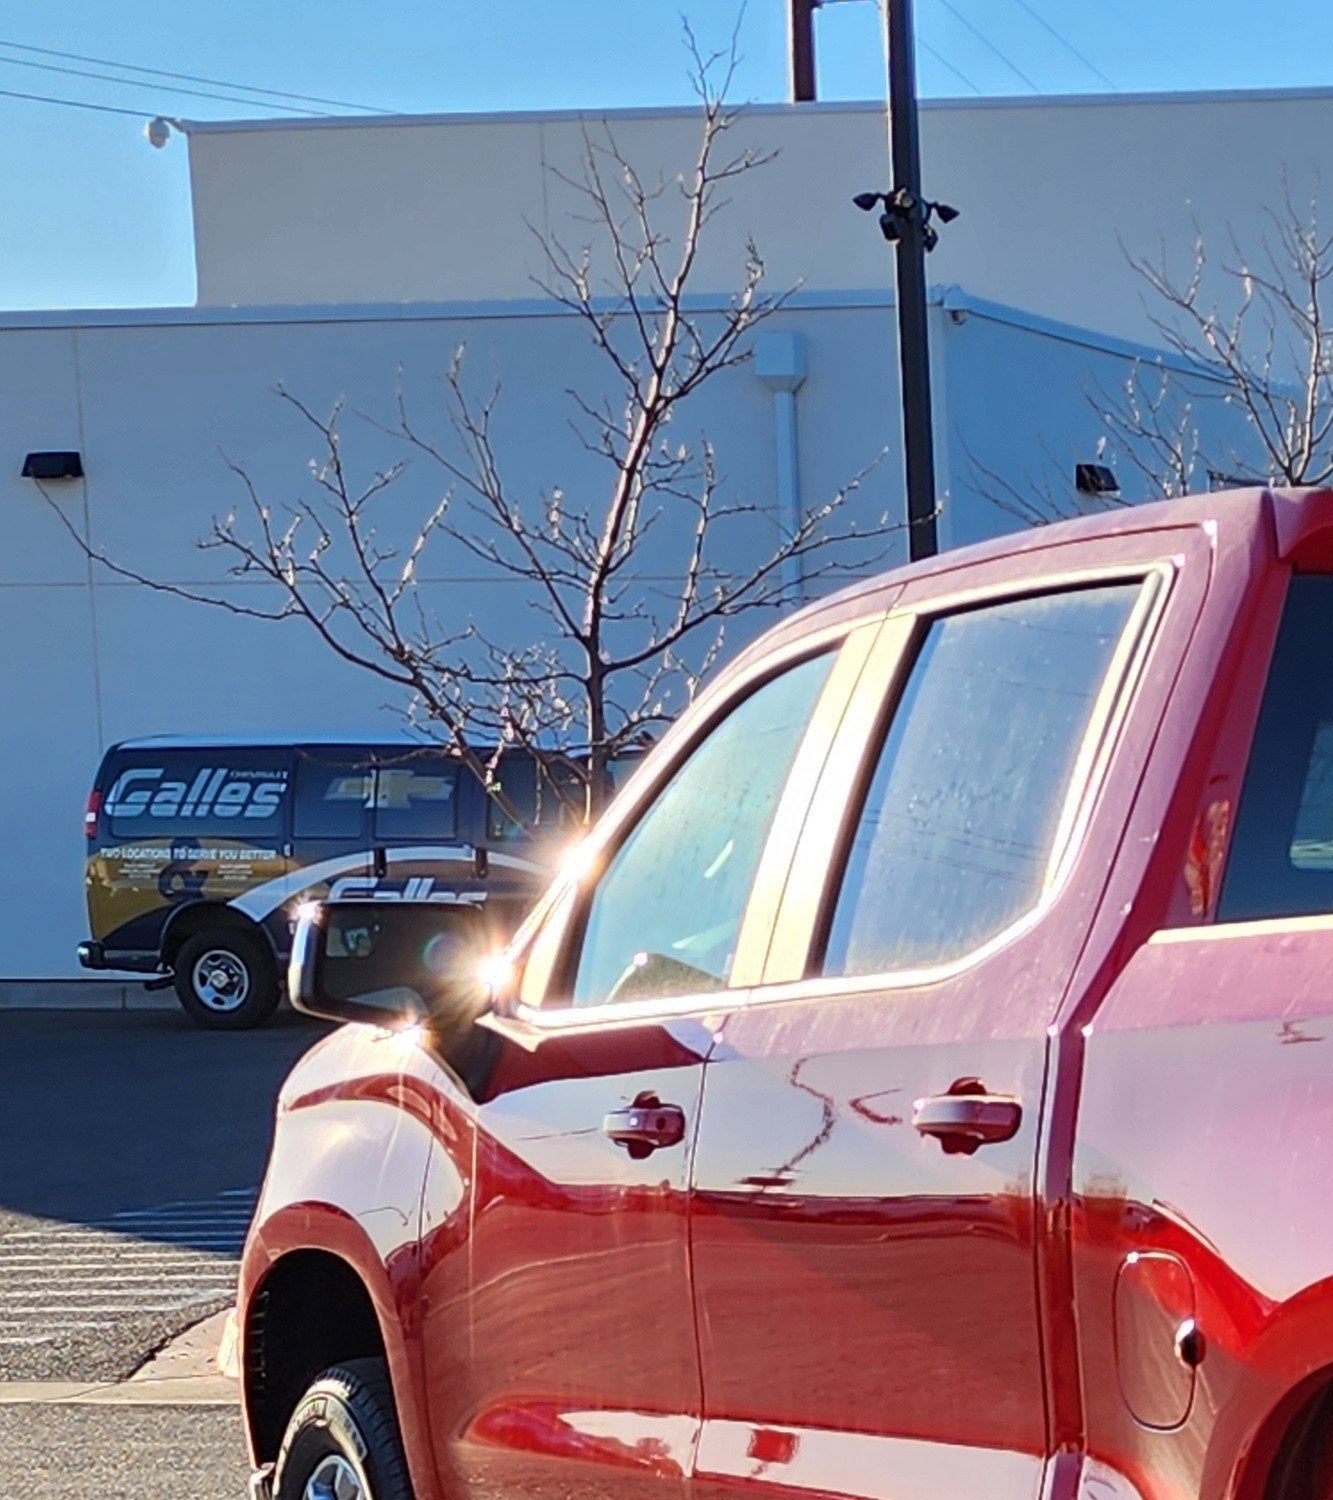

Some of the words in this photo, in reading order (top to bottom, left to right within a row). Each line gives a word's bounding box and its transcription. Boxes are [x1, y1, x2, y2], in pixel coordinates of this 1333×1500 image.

[104, 767, 287, 818] Galles
[122, 848, 171, 860] LOCATIONS
[173, 848, 186, 860] TO
[219, 849, 239, 860] YOU
[240, 849, 277, 860] BETTER
